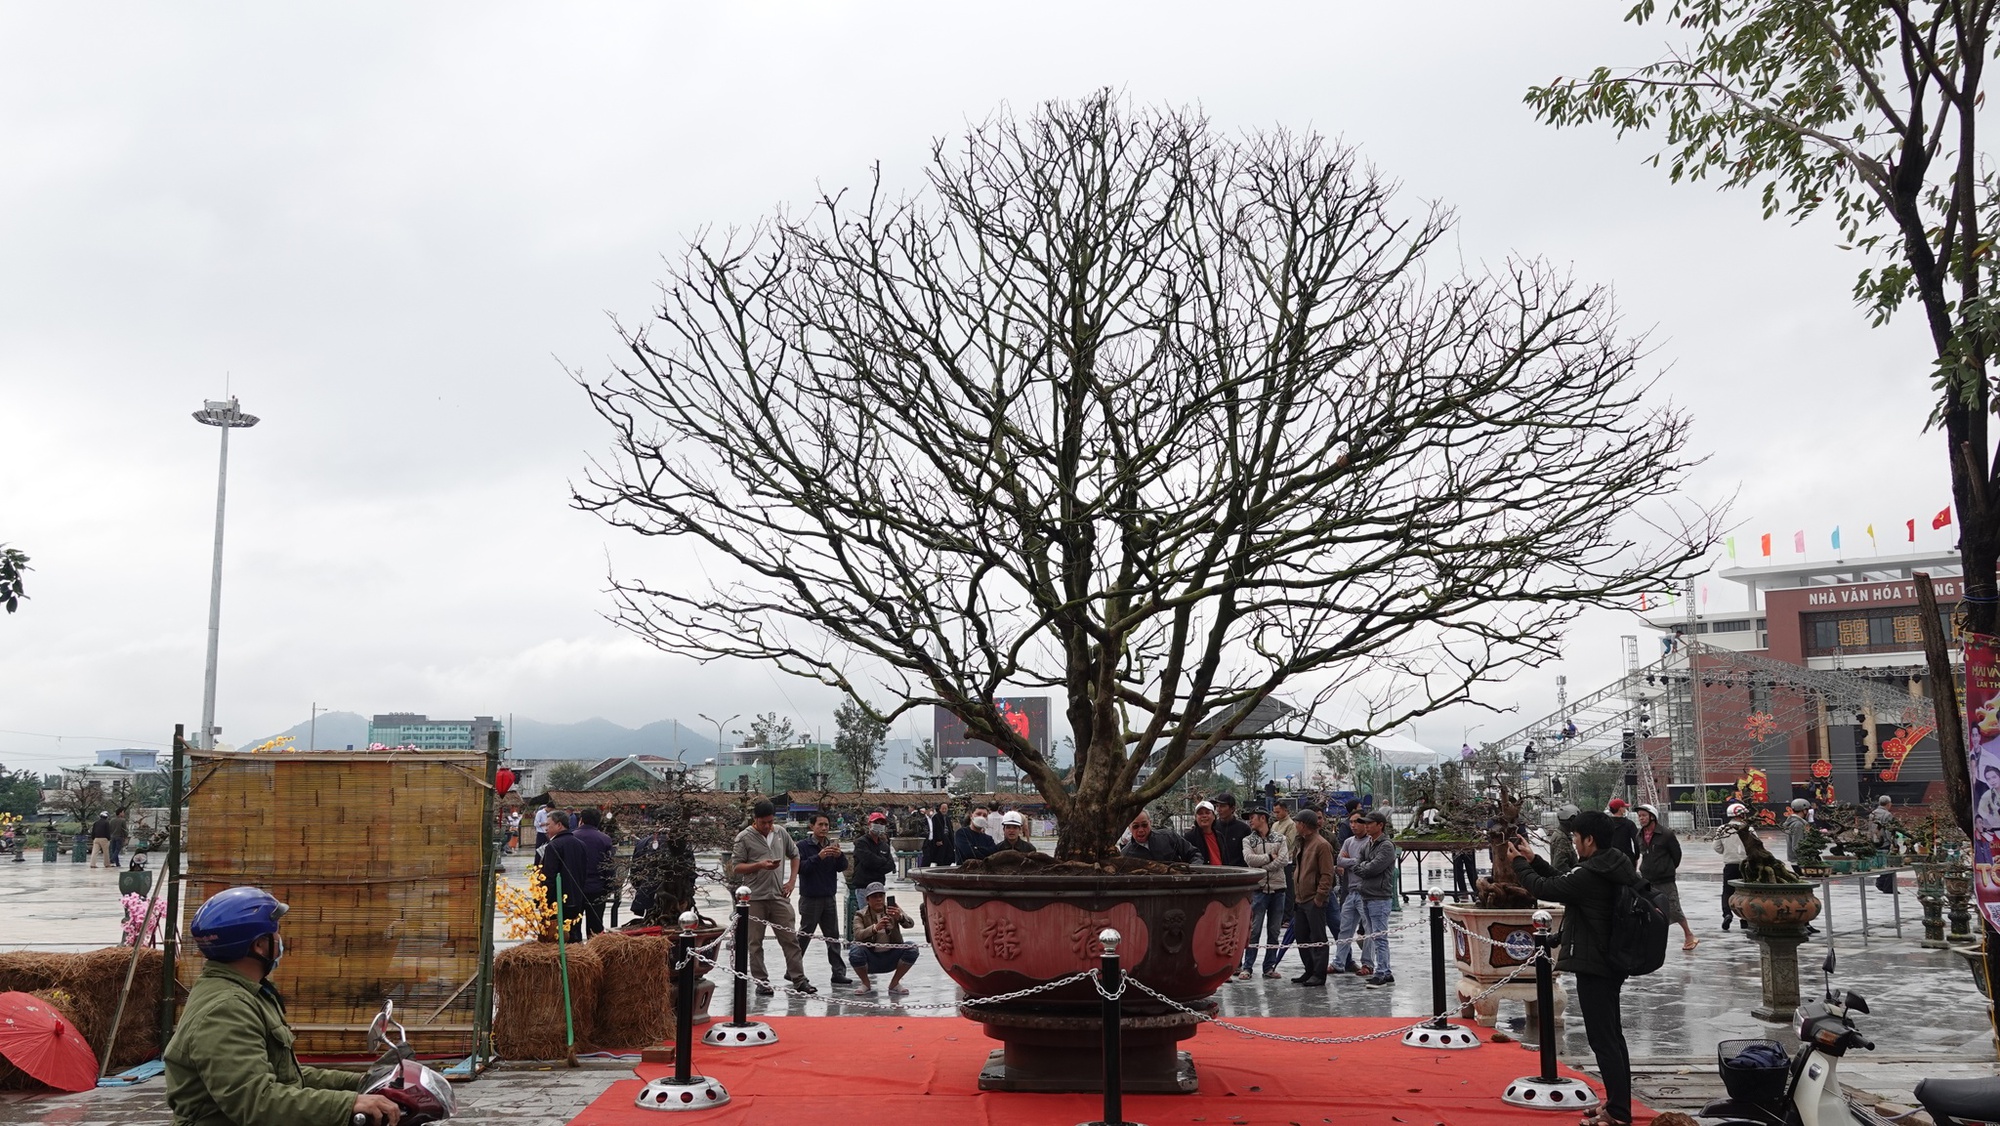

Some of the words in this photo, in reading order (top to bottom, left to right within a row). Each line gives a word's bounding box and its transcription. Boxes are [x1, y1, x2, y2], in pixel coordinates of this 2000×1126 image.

[1809, 588, 1837, 605] NHÀ
[1841, 587, 1868, 602] VĂN
[1873, 584, 1901, 601] HÓA
[1906, 582, 1954, 598] TNG
